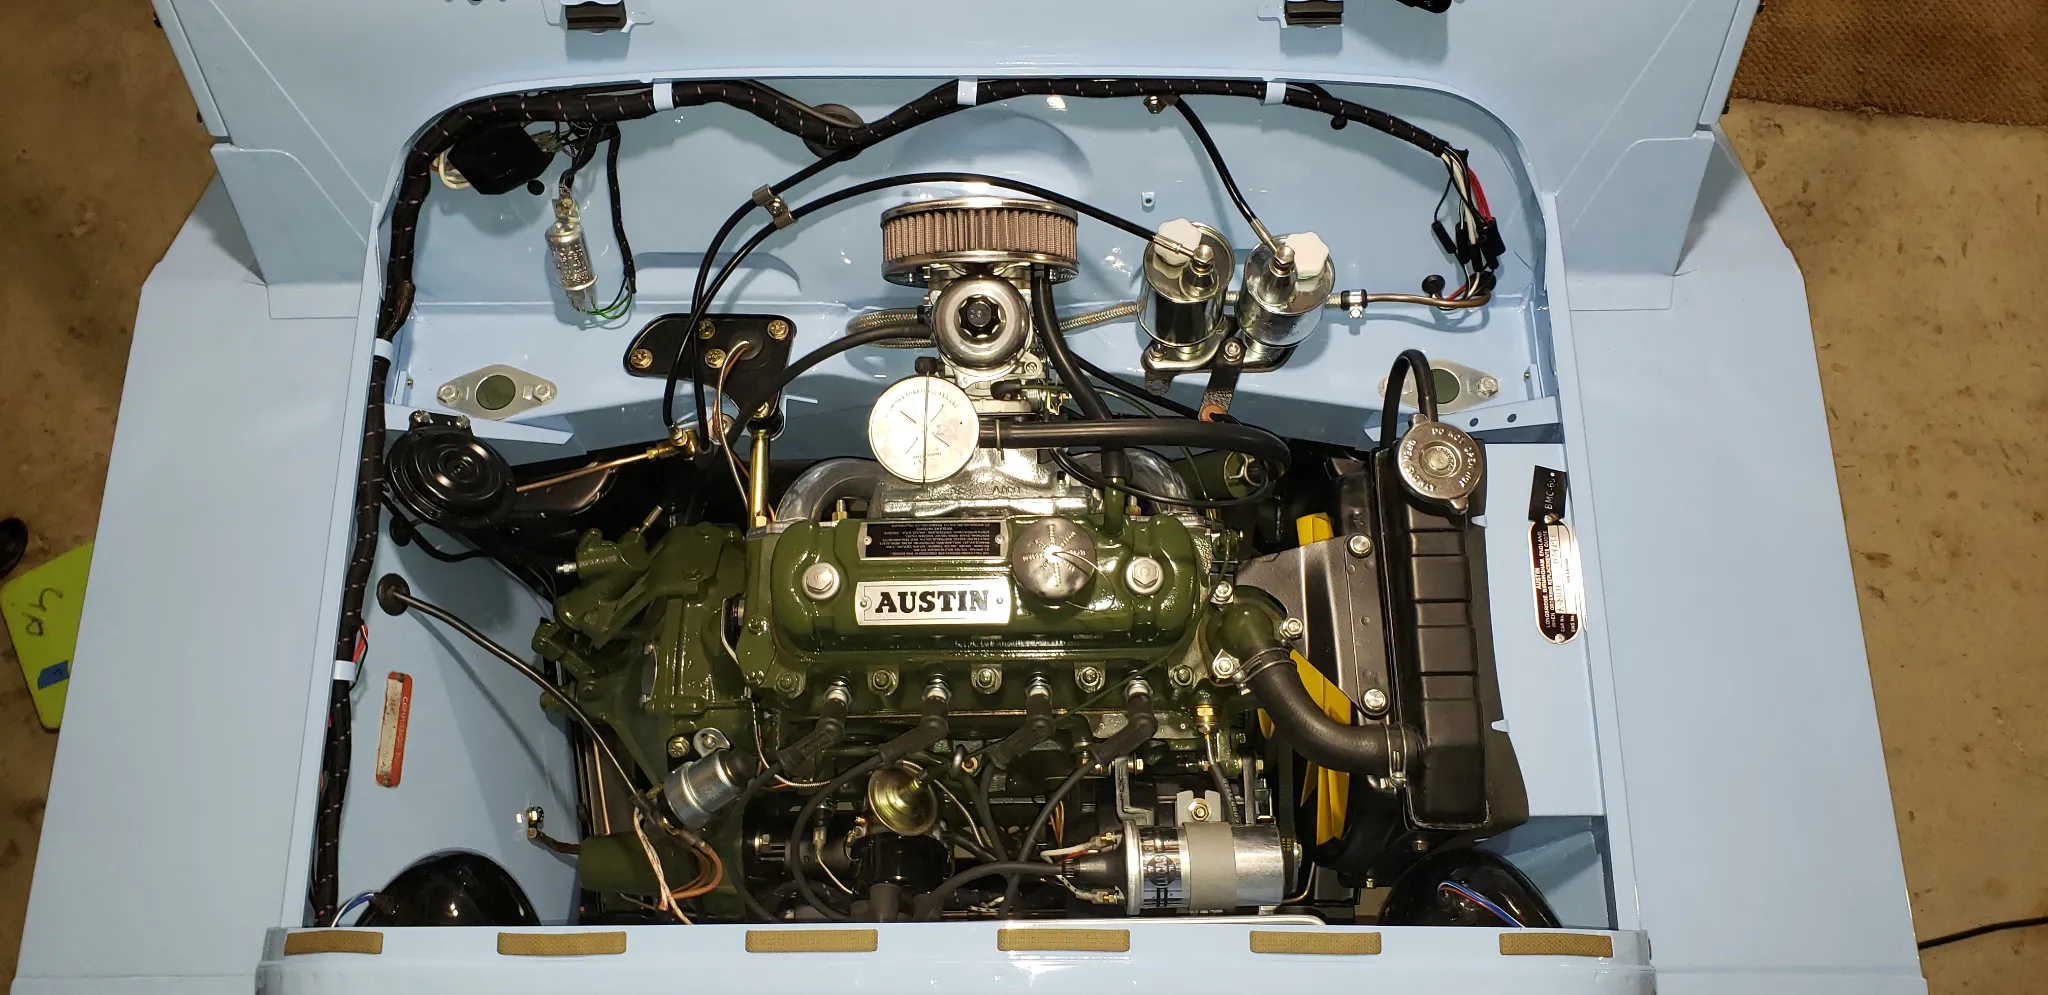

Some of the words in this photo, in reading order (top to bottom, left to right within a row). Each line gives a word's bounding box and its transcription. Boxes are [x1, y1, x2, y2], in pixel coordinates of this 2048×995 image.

[1537, 531, 1545, 557] ENGLAND
[874, 589, 989, 614] AUSTIN
[1154, 855, 1168, 885] LUCAS
